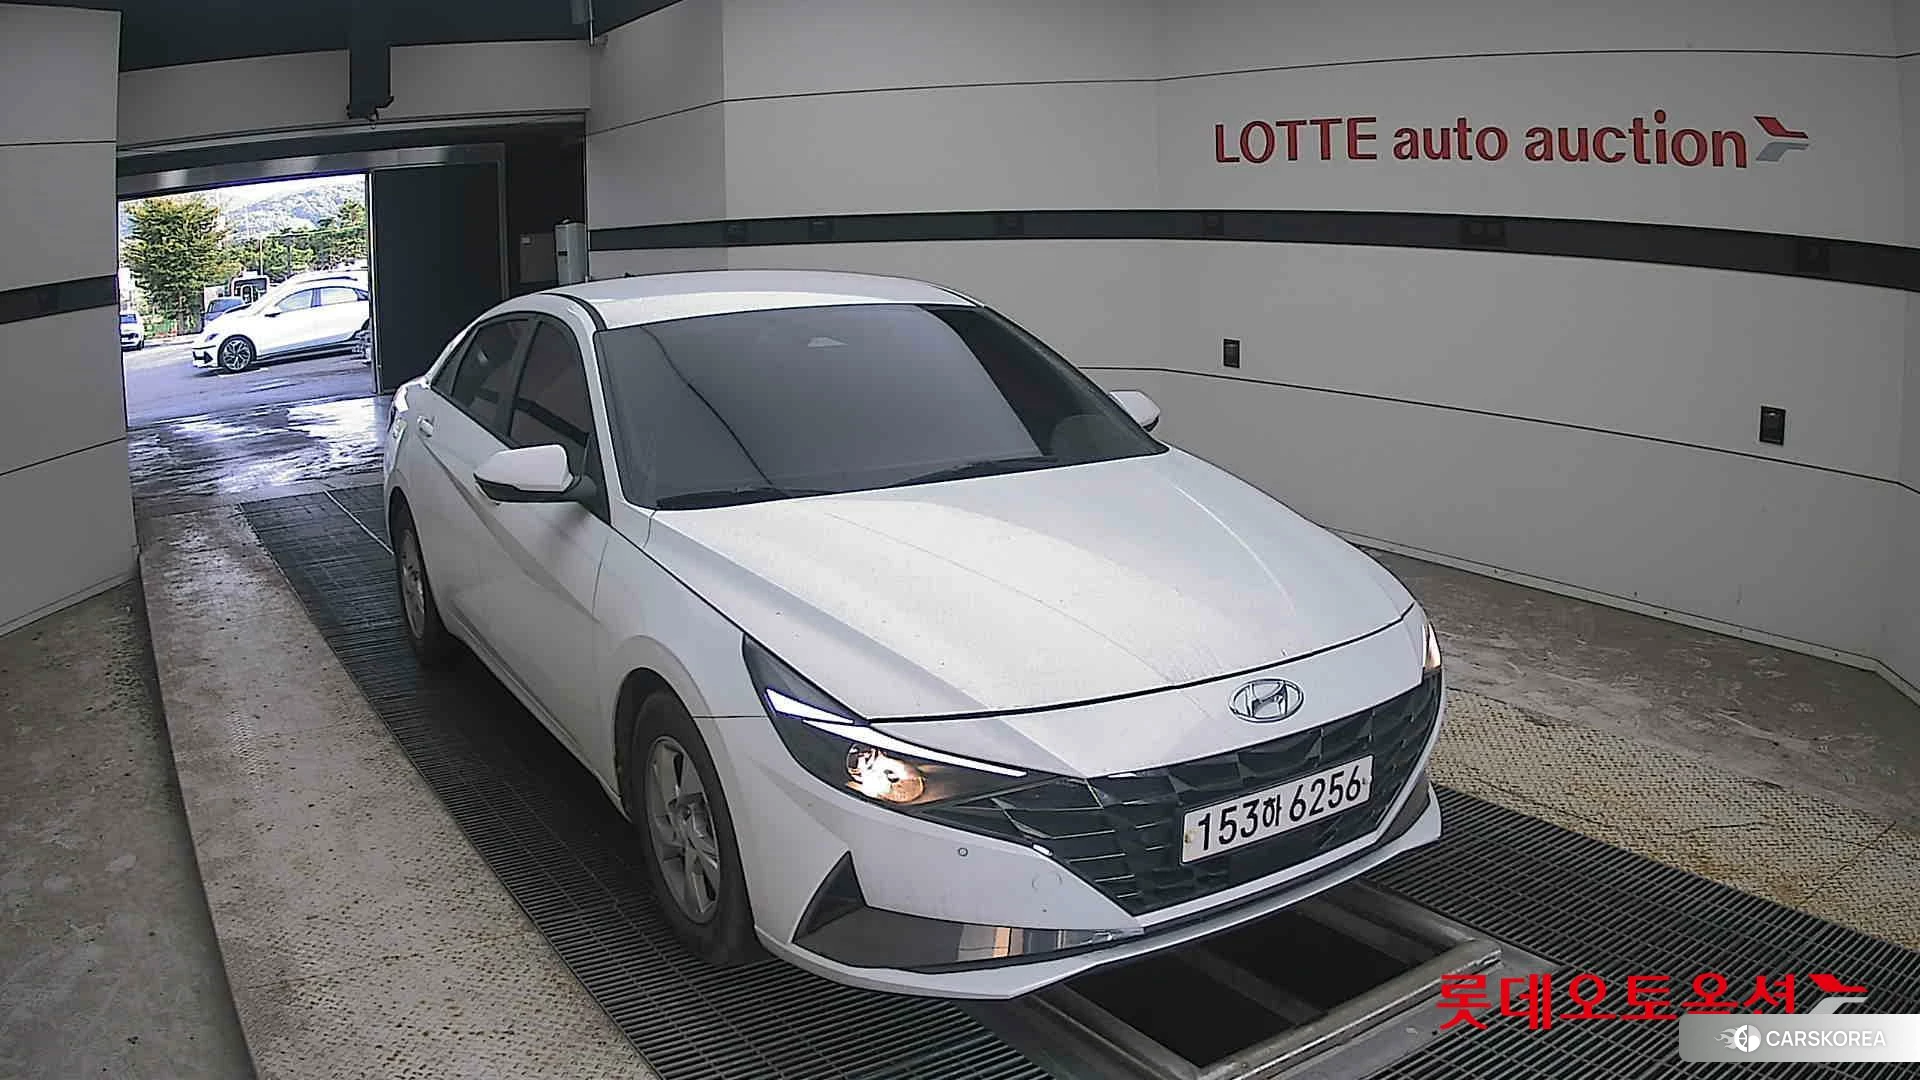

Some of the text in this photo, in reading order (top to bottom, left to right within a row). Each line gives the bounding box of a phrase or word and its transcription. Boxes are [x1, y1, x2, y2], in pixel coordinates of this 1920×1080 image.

[1215, 109, 1747, 168] LOTTE auto auction
